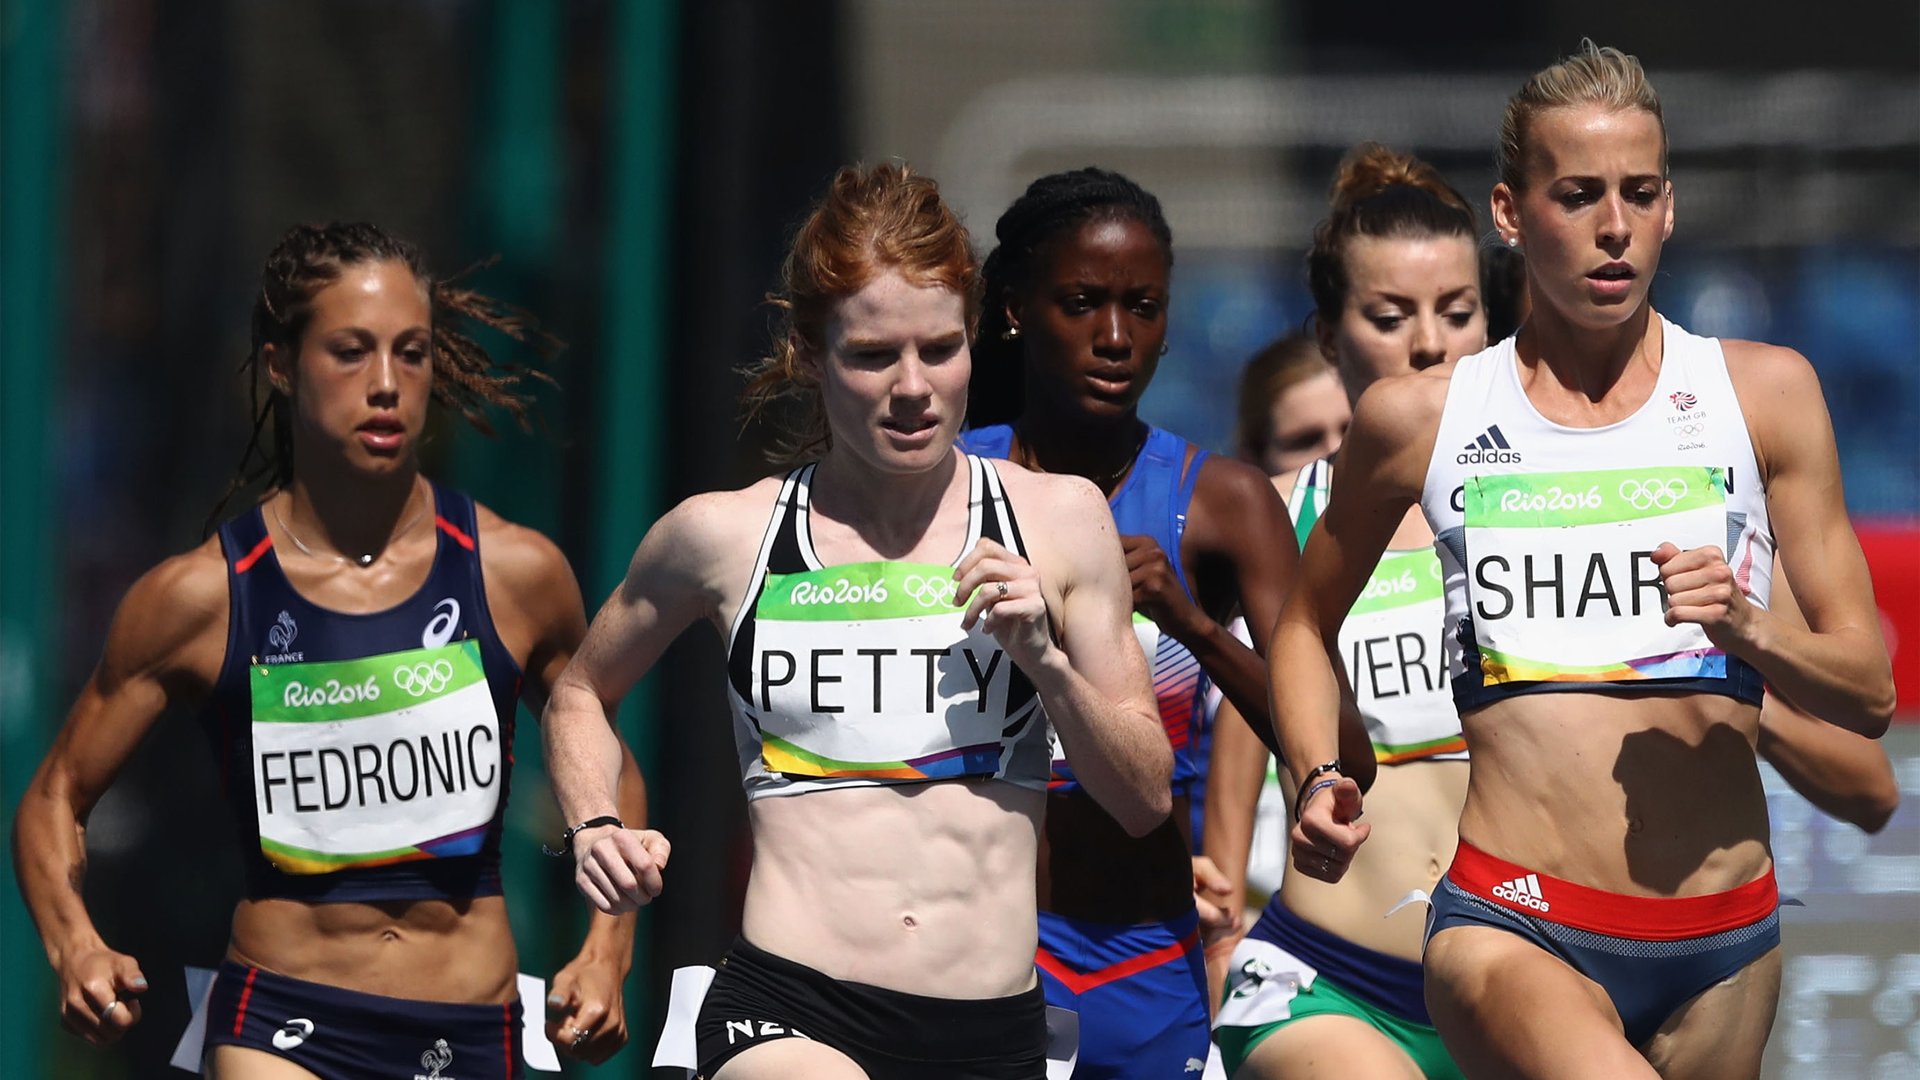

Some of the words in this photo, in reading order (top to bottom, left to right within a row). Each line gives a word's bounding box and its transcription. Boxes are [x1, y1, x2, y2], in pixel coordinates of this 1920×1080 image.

[1667, 414, 1692, 424] TEAM
[1694, 411, 1707, 420] GB
[1456, 449, 1522, 464] adidas
[1501, 485, 1603, 512] Rio2016
[790, 577, 888, 606] Rio2016
[1475, 550, 1697, 622] SHAR
[265, 651, 304, 664] FRANCE
[284, 675, 381, 708] Rio2016
[761, 648, 1004, 714] PETTY
[261, 725, 495, 815] FEDRONIC
[1492, 885, 1550, 912] adidas
